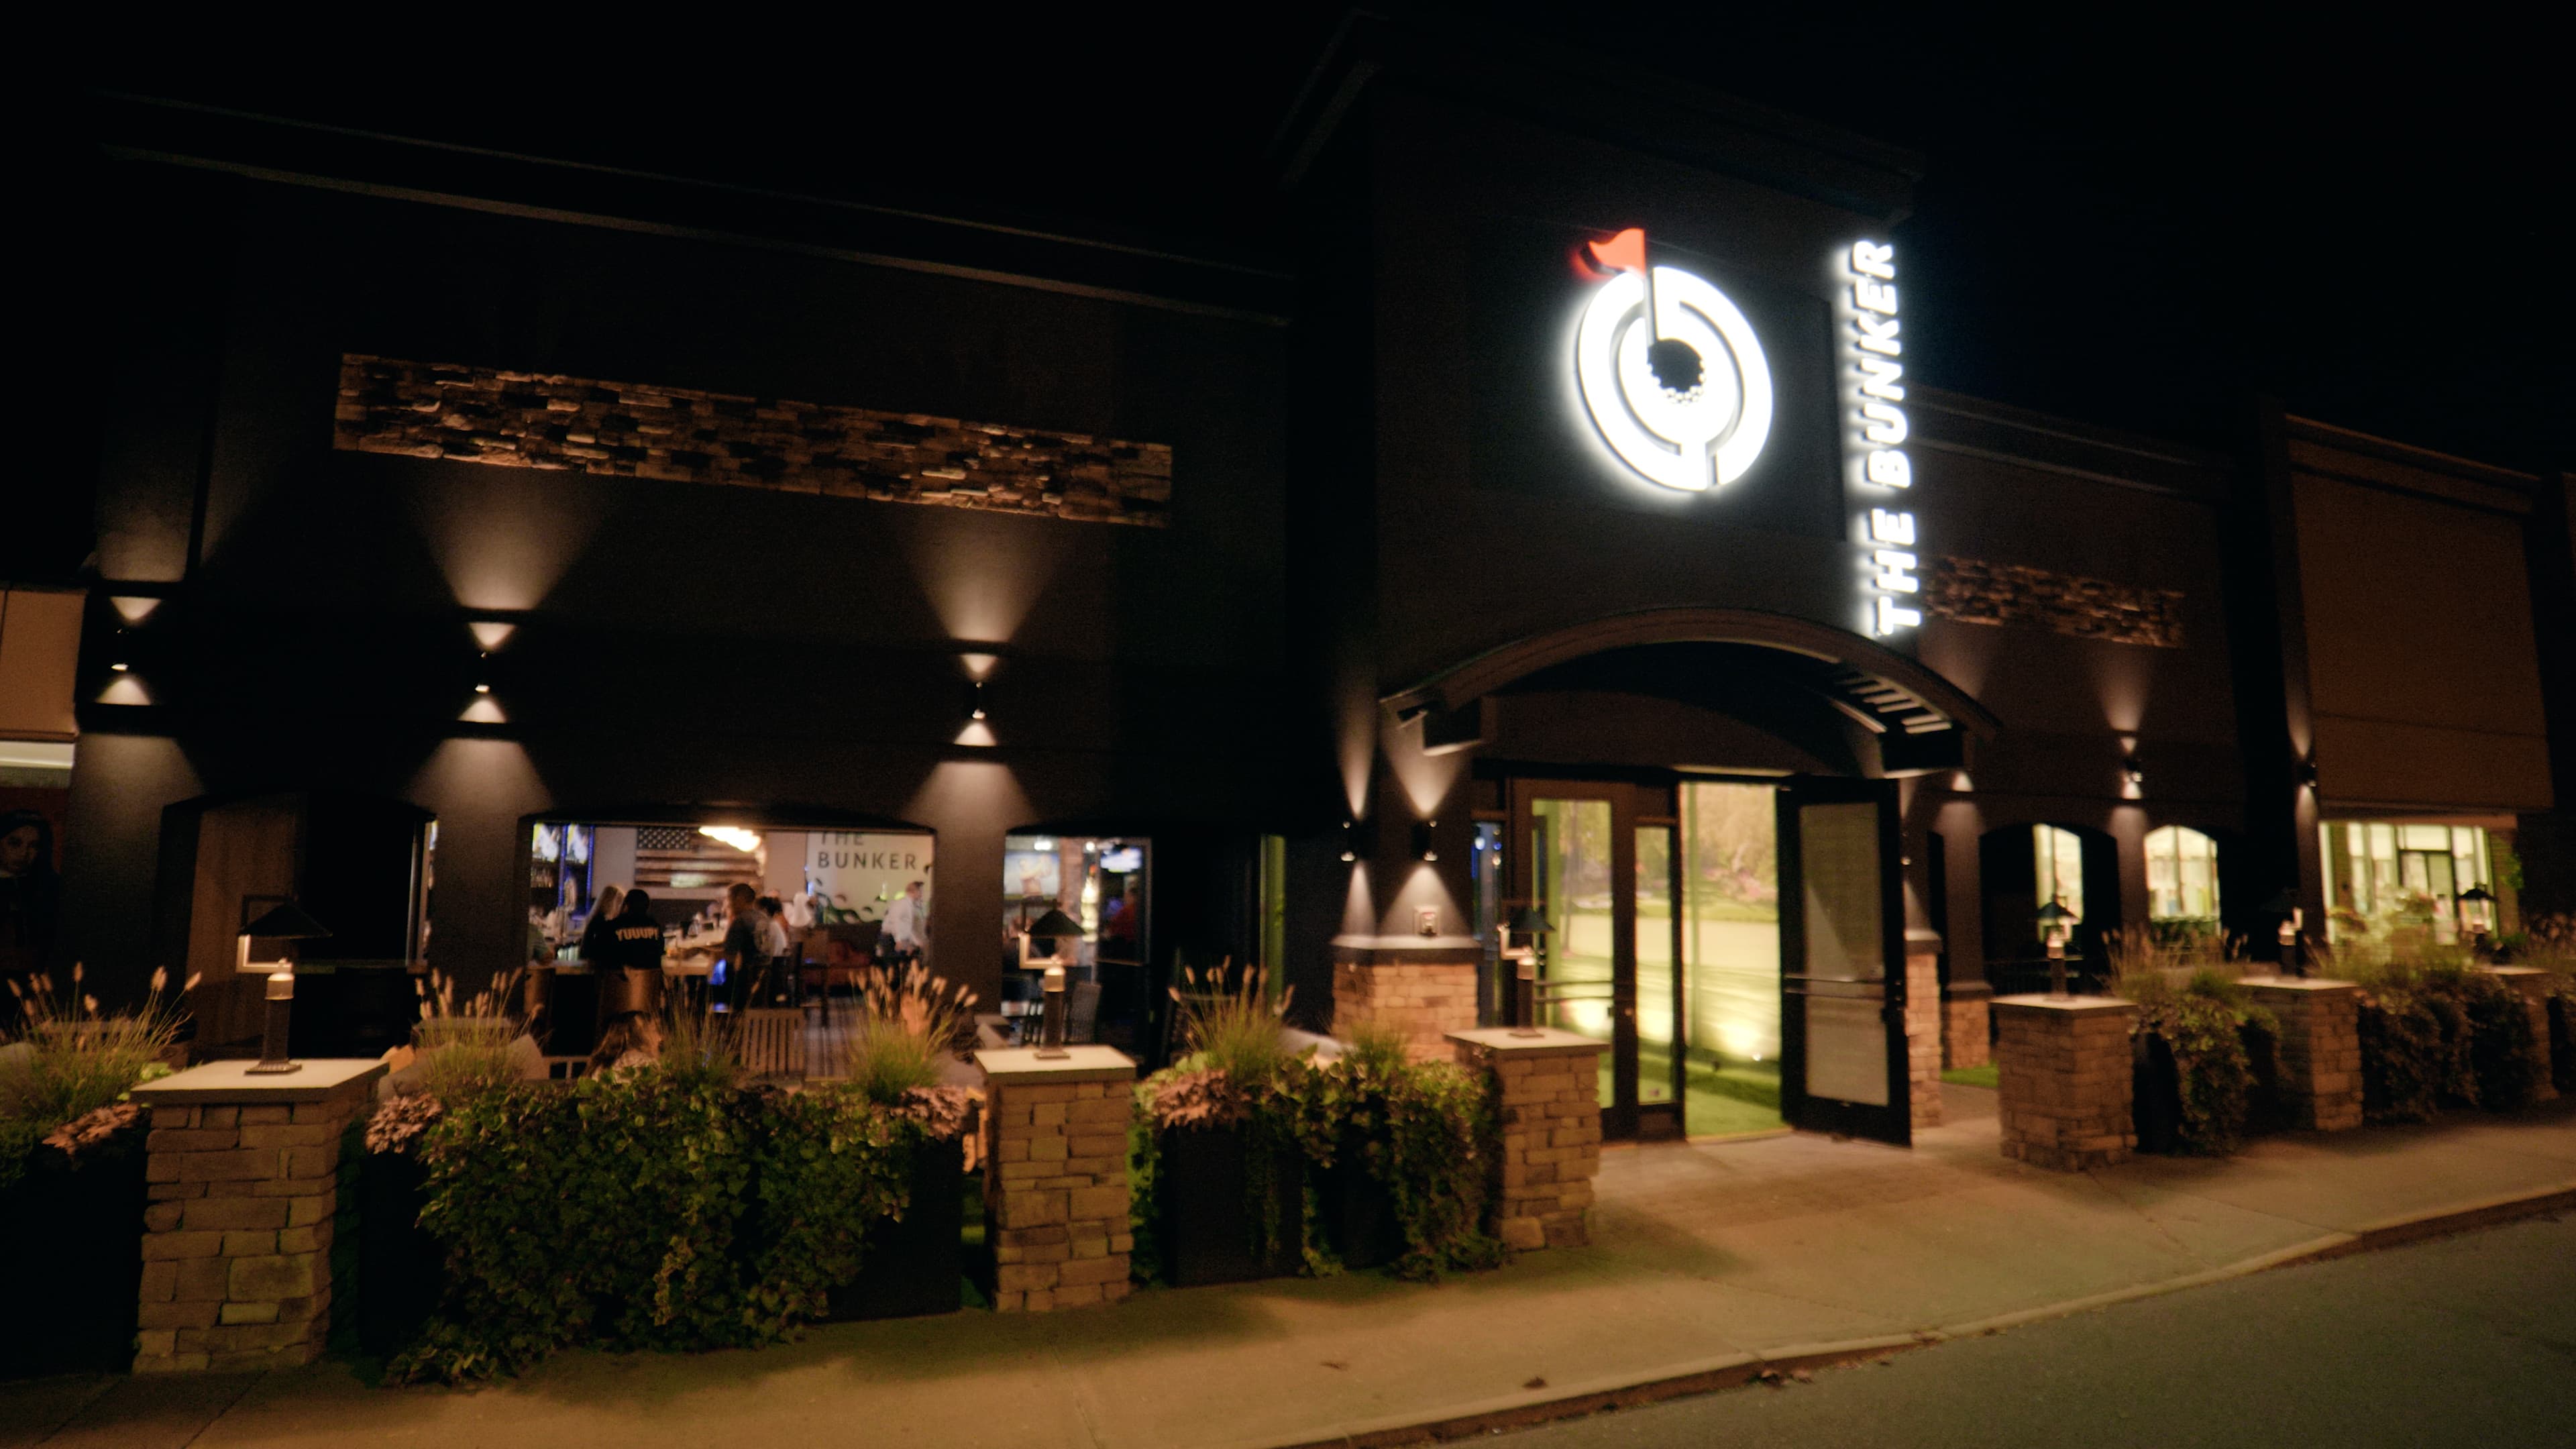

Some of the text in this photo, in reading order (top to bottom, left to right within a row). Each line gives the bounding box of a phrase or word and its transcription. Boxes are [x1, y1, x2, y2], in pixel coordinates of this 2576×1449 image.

[1853, 241, 1921, 635] THE BUNKER
[821, 832, 864, 845] THE
[818, 851, 916, 870] BUNKER
